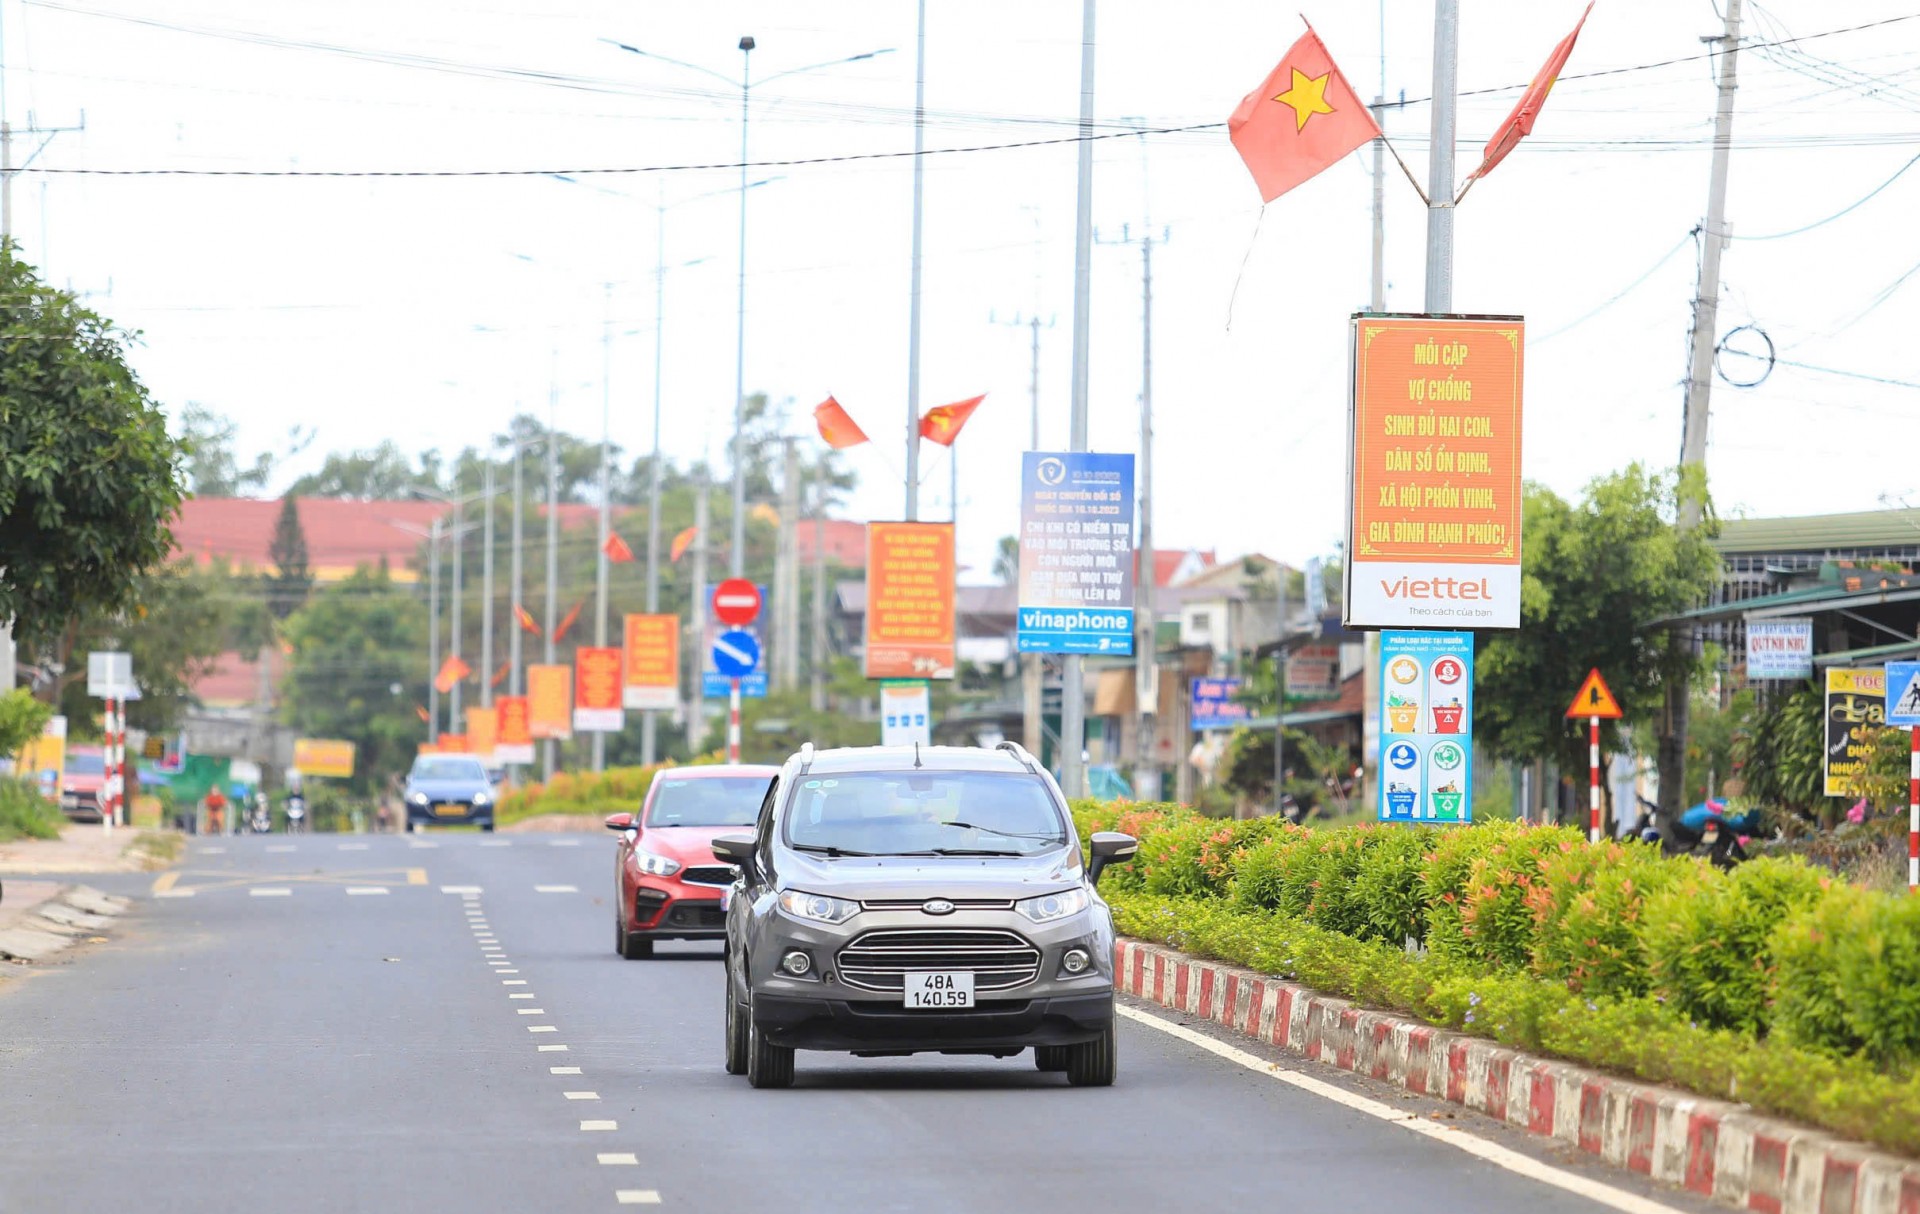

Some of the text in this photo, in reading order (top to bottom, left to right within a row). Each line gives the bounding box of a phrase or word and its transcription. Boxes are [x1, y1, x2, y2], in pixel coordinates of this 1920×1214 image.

[1414, 337, 1468, 370] MỖI CẶP
[1408, 374, 1472, 405] VỢ CHỒNG
[1384, 414, 1415, 436] SINH
[1417, 408, 1436, 437] ĐỦ
[1439, 416, 1460, 437] HAI
[1385, 443, 1492, 477] DÂN SỐ ỔN ĐỊNH,
[1379, 482, 1396, 507] XÃ
[1400, 482, 1421, 512] HỘI
[1463, 488, 1497, 512] VINH,
[1369, 518, 1505, 548] GIA ĐÌNH HẠNH PHÚC!
[1380, 576, 1492, 600] viettel
[1022, 610, 1128, 632] vinaphone
[1409, 607, 1492, 618] Theo cách của bạn
[924, 975, 954, 989] 48A
[914, 991, 967, 1006] 140.59
